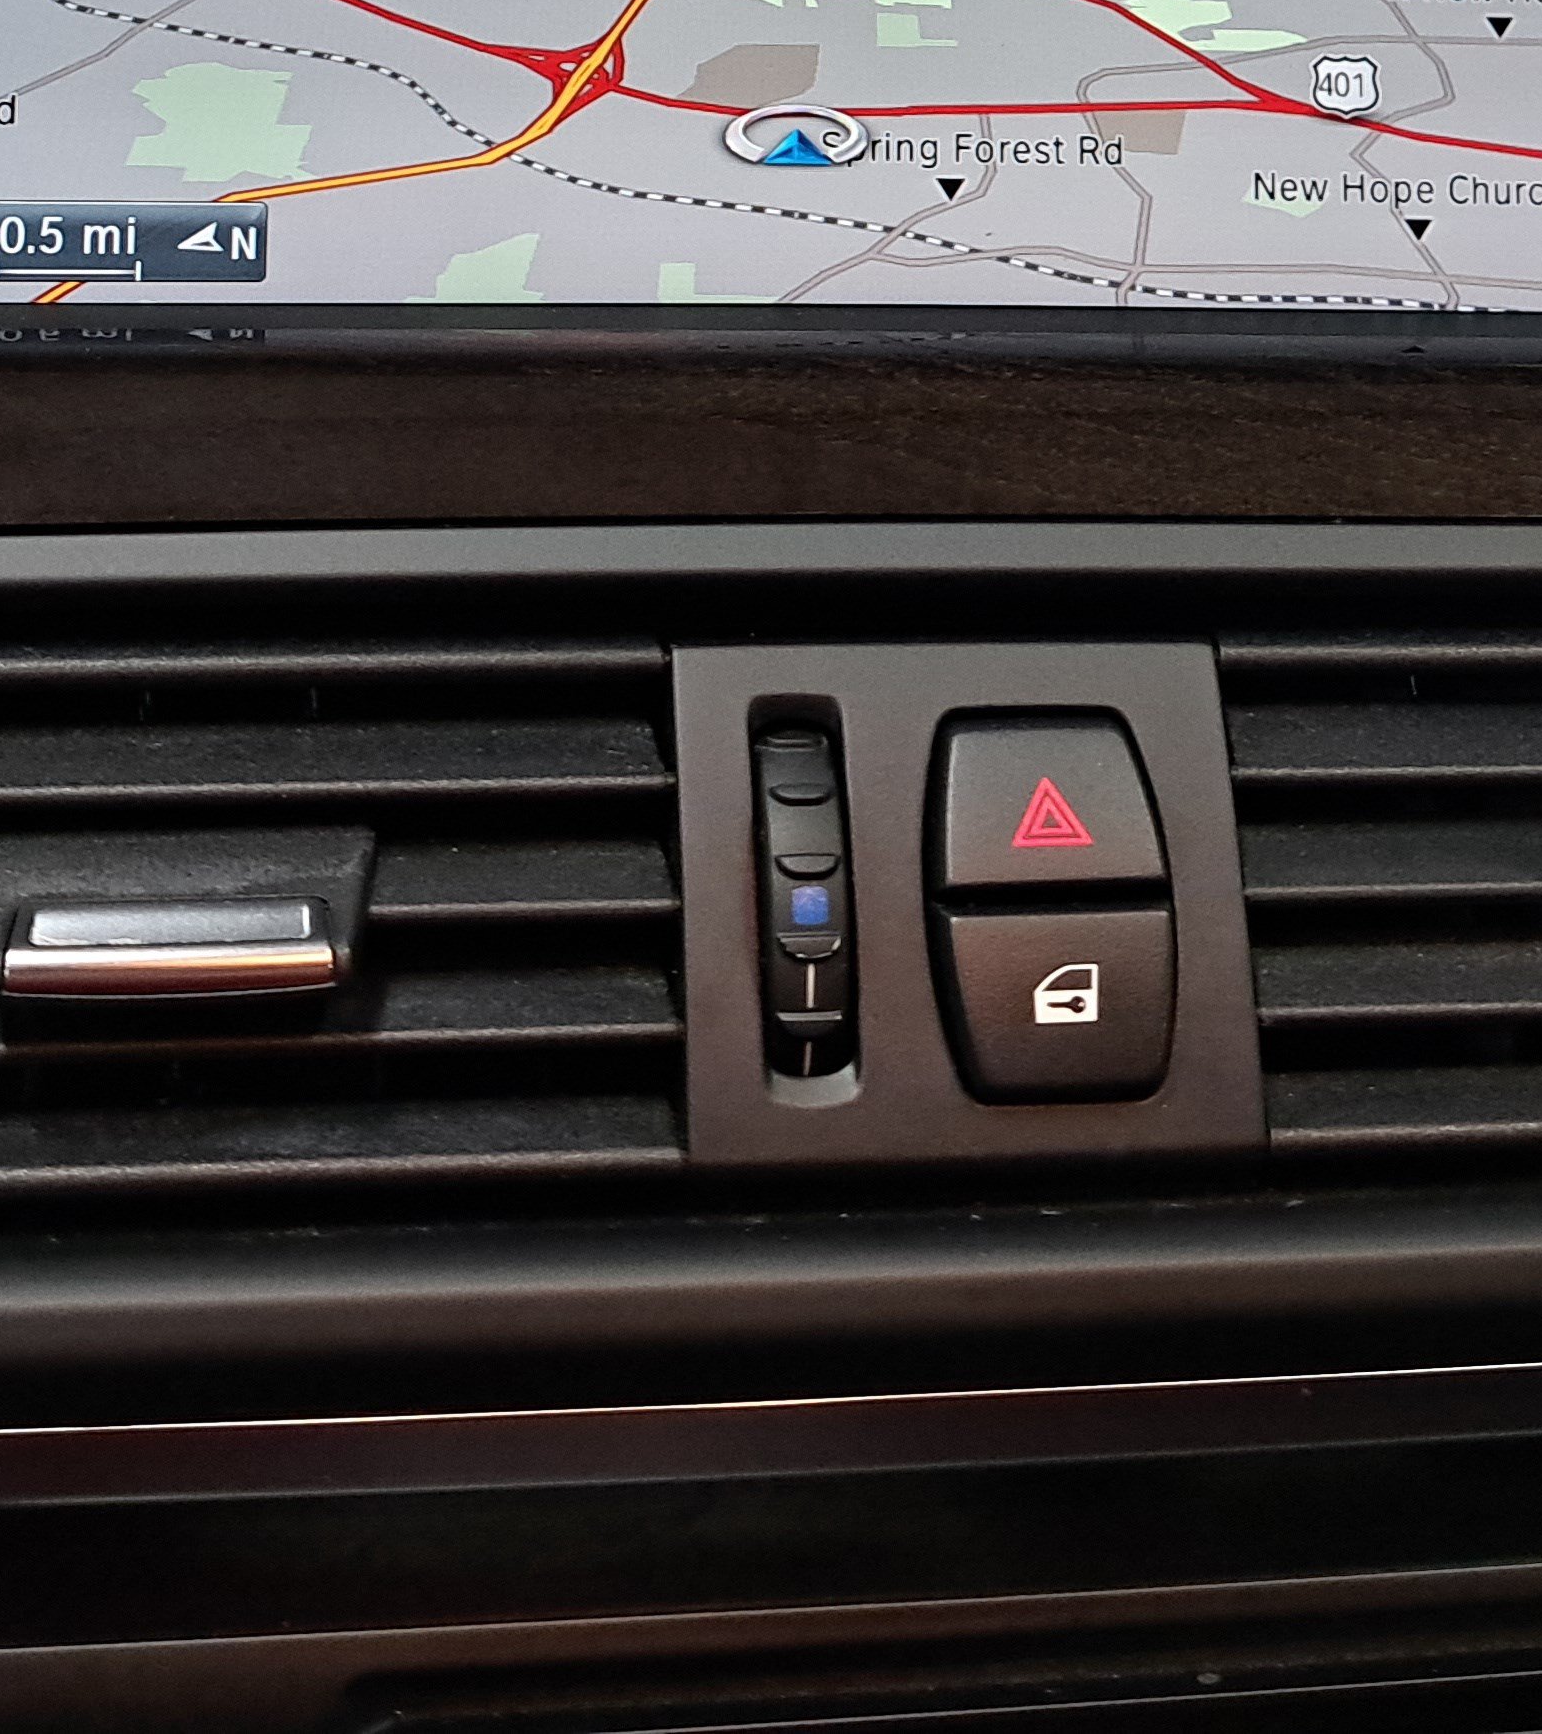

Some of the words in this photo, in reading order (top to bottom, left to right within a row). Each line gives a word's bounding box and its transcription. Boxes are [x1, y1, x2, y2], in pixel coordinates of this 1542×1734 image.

[1317, 69, 1365, 98] 401
[955, 133, 1064, 165] Forest
[1079, 135, 1122, 166] Rd
[1254, 172, 1328, 202] New
[1343, 174, 1434, 210] Hope
[0, 216, 63, 254] 0.5
[83, 216, 137, 255] mi
[231, 226, 257, 260] N
